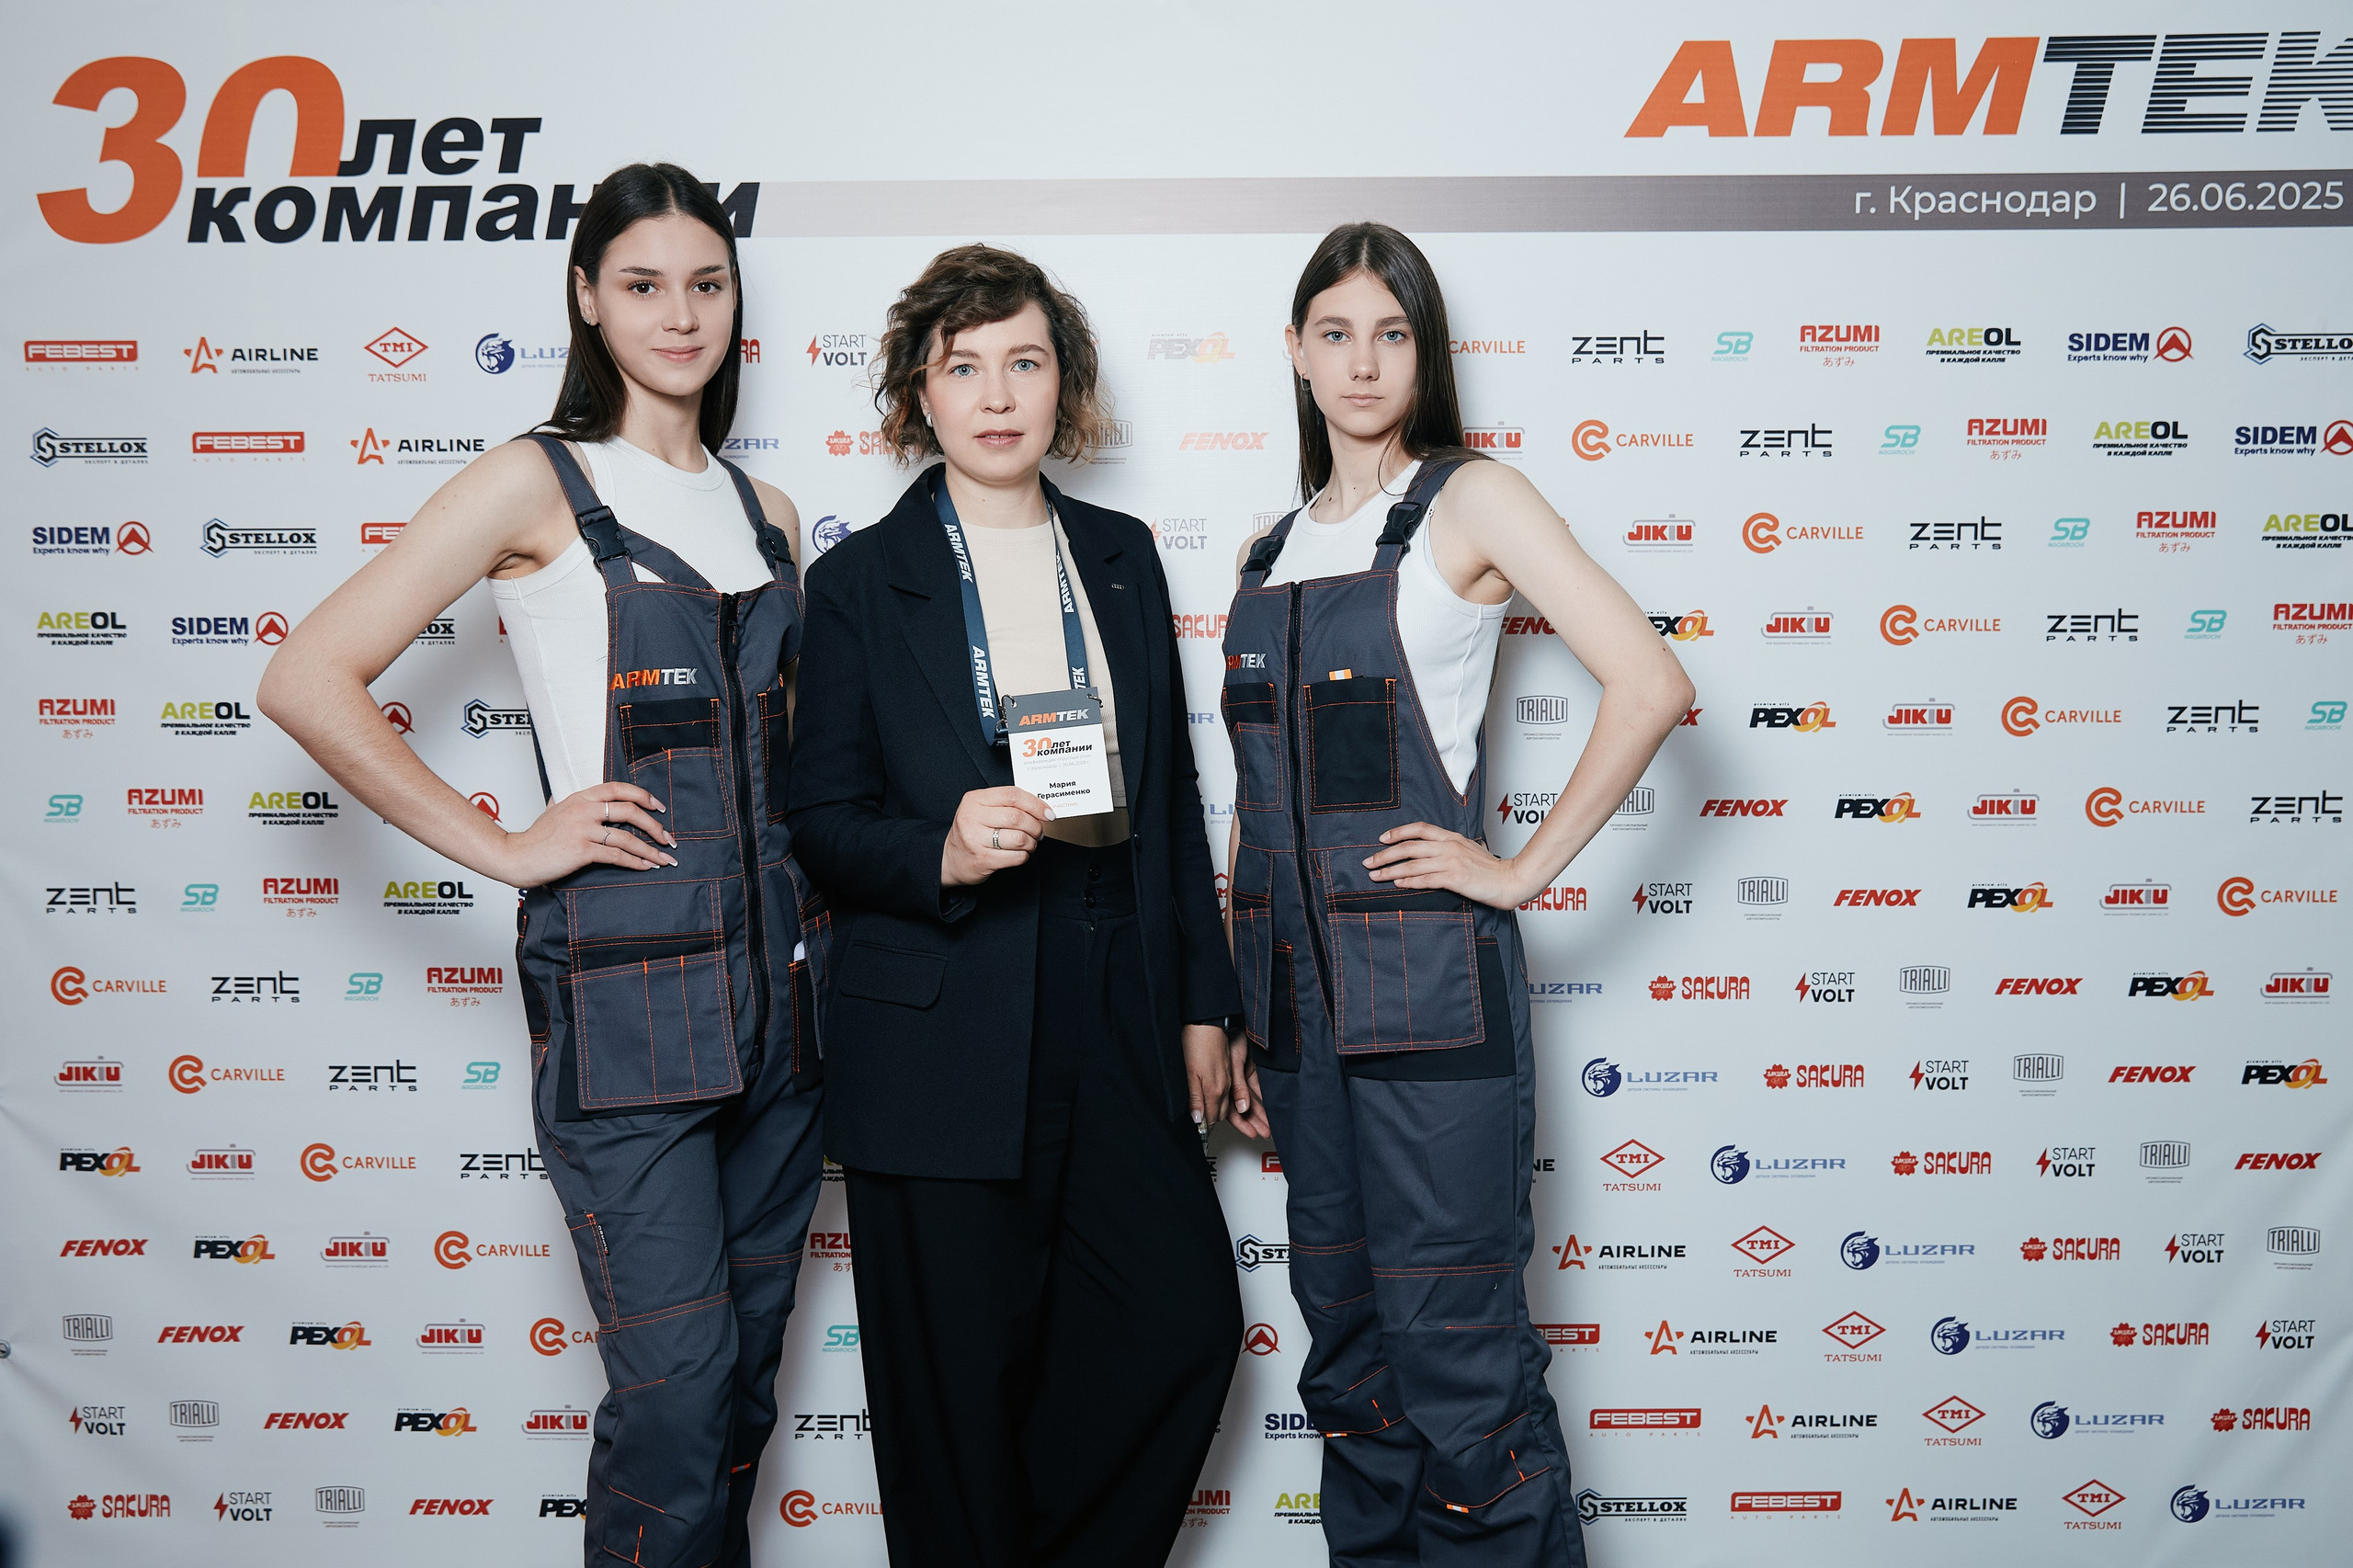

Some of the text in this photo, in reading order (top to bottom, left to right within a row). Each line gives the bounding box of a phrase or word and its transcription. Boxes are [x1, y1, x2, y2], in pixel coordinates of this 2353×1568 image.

[1623, 31, 2353, 137] ARMTEK
[37, 56, 542, 244] 30 лет
[1854, 181, 2345, 221] г. Краснодар 26.06.2025
[1800, 324, 1880, 342] AZUMI
[1926, 327, 2021, 347] AREOL
[378, 342, 415, 353] TMI
[823, 335, 868, 348] START
[1449, 340, 1526, 354] CARVILLE
[2067, 333, 2149, 351] SIDEM
[2274, 337, 2353, 350] STELLO
[27, 345, 134, 358] FEBEST
[230, 347, 320, 361] AIRLINE
[1146, 334, 1236, 364] PEXOL
[823, 351, 868, 366] VOLT
[2068, 353, 2149, 363] Experts know why
[365, 372, 426, 382] TATSUMI
[1967, 418, 2047, 436] AZUMI
[2094, 421, 2188, 439] AREOL
[1178, 432, 1269, 450] FENOX
[1616, 434, 1694, 447] CARVILLE
[2234, 425, 2316, 445] SIDEM
[56, 441, 150, 454] STELLOX
[196, 437, 301, 449] FEBEST
[397, 438, 485, 452] AIRLINE
[1162, 517, 1208, 531] START
[2136, 510, 2216, 528] AZUMI
[31, 526, 110, 545] SIDEM
[226, 532, 318, 545] STELLOX
[1627, 524, 1692, 540] JIKIU
[1786, 526, 1864, 540] CARVILLE
[1162, 535, 1208, 550] VOLT
[944, 524, 973, 583] ARMTEK
[172, 617, 249, 635] SIDEM
[1766, 617, 1829, 632] JIKIU
[172, 637, 203, 646] Experts
[230, 637, 248, 646] why
[609, 668, 698, 690] ARMTEK
[972, 645, 995, 720] ARMTEK
[39, 699, 116, 716] AZUMI
[161, 702, 251, 720] AREOL
[1518, 698, 1564, 721] TRIALLI
[1018, 709, 1089, 726] ARMTEK
[1022, 737, 1071, 757] 30 лет
[1037, 744, 1093, 756] компании
[1049, 780, 1076, 790] Мария
[1037, 789, 1091, 800] Герасименко
[1699, 800, 1789, 817] FENOX
[1835, 794, 1921, 824] PEXOL
[1972, 799, 2035, 814] JIKIU
[2129, 800, 2205, 813] CARVILLE
[383, 881, 473, 899] AREOL
[2260, 890, 2338, 903] CARVILLE
[426, 967, 503, 983] AZUMI
[1811, 971, 1856, 985] START
[1902, 968, 1947, 991] TRIALLI
[93, 980, 165, 993] CARVILLE
[1529, 983, 1603, 994] UZAR
[1681, 976, 1750, 1000] SAKURA
[1995, 977, 2083, 994] FENOX
[2128, 972, 2215, 1002] PEXOL
[2265, 977, 2329, 993] JIKIU
[1811, 989, 1855, 1003] VOLT
[1627, 1072, 1718, 1084] LUZAR
[1796, 1064, 1865, 1088] SAKURA
[2109, 1065, 2196, 1083] FENOX
[2242, 1060, 2327, 1089] PEXOL
[1615, 1153, 1650, 1164] TMI
[2052, 1146, 2097, 1160] START
[2143, 1143, 2187, 1165] TRIALLI
[190, 1153, 252, 1169] JIKIU
[343, 1156, 415, 1169] CARVILLE
[1754, 1158, 1847, 1170] LUZAR
[2234, 1153, 2322, 1170] FENOX
[2052, 1164, 2096, 1177] VOLT
[1602, 1183, 1662, 1192] TATSUMI
[60, 1239, 151, 1256] FENOX
[192, 1235, 276, 1264] PEXOL
[476, 1244, 551, 1256] CARVILLE
[1598, 1244, 1687, 1258] AIRLINE
[1745, 1240, 1780, 1250] TMI
[1884, 1244, 1975, 1256] LUZAR
[2053, 1237, 2120, 1260] SAKURA
[1733, 1268, 1791, 1278] TATSUMI
[65, 1316, 109, 1338] TRIALLI
[2271, 1319, 2315, 1333] START
[158, 1325, 245, 1343] FENOX
[1690, 1330, 1779, 1344] AIRLINE
[1974, 1329, 2065, 1342] LUZAR
[2143, 1323, 2210, 1346] SAKURA
[2271, 1335, 2314, 1349] VOLT
[1824, 1353, 1881, 1362] TATSUMI
[263, 1412, 350, 1429] FENOX
[394, 1408, 476, 1436] PEXOL
[1594, 1412, 1697, 1426] FEBEST
[1790, 1414, 1879, 1427] AIRLINE
[1937, 1410, 1971, 1420] TMI
[2074, 1414, 2165, 1426] LUZAR
[2243, 1408, 2310, 1431] SAKURA
[526, 1415, 587, 1430] JIKIU
[1265, 1432, 1296, 1440] Experts
[1925, 1437, 1982, 1447] TATSUMI
[230, 1492, 273, 1505] START
[317, 1488, 361, 1510] TRIALLI
[1734, 1494, 1838, 1508] FEBEST
[1931, 1497, 2018, 1511] AIRLINE
[2214, 1498, 2305, 1510] LUZAR
[102, 1494, 171, 1518] SAKURA
[1599, 1501, 1688, 1513] STELLOX
[230, 1508, 272, 1522] VOLT
